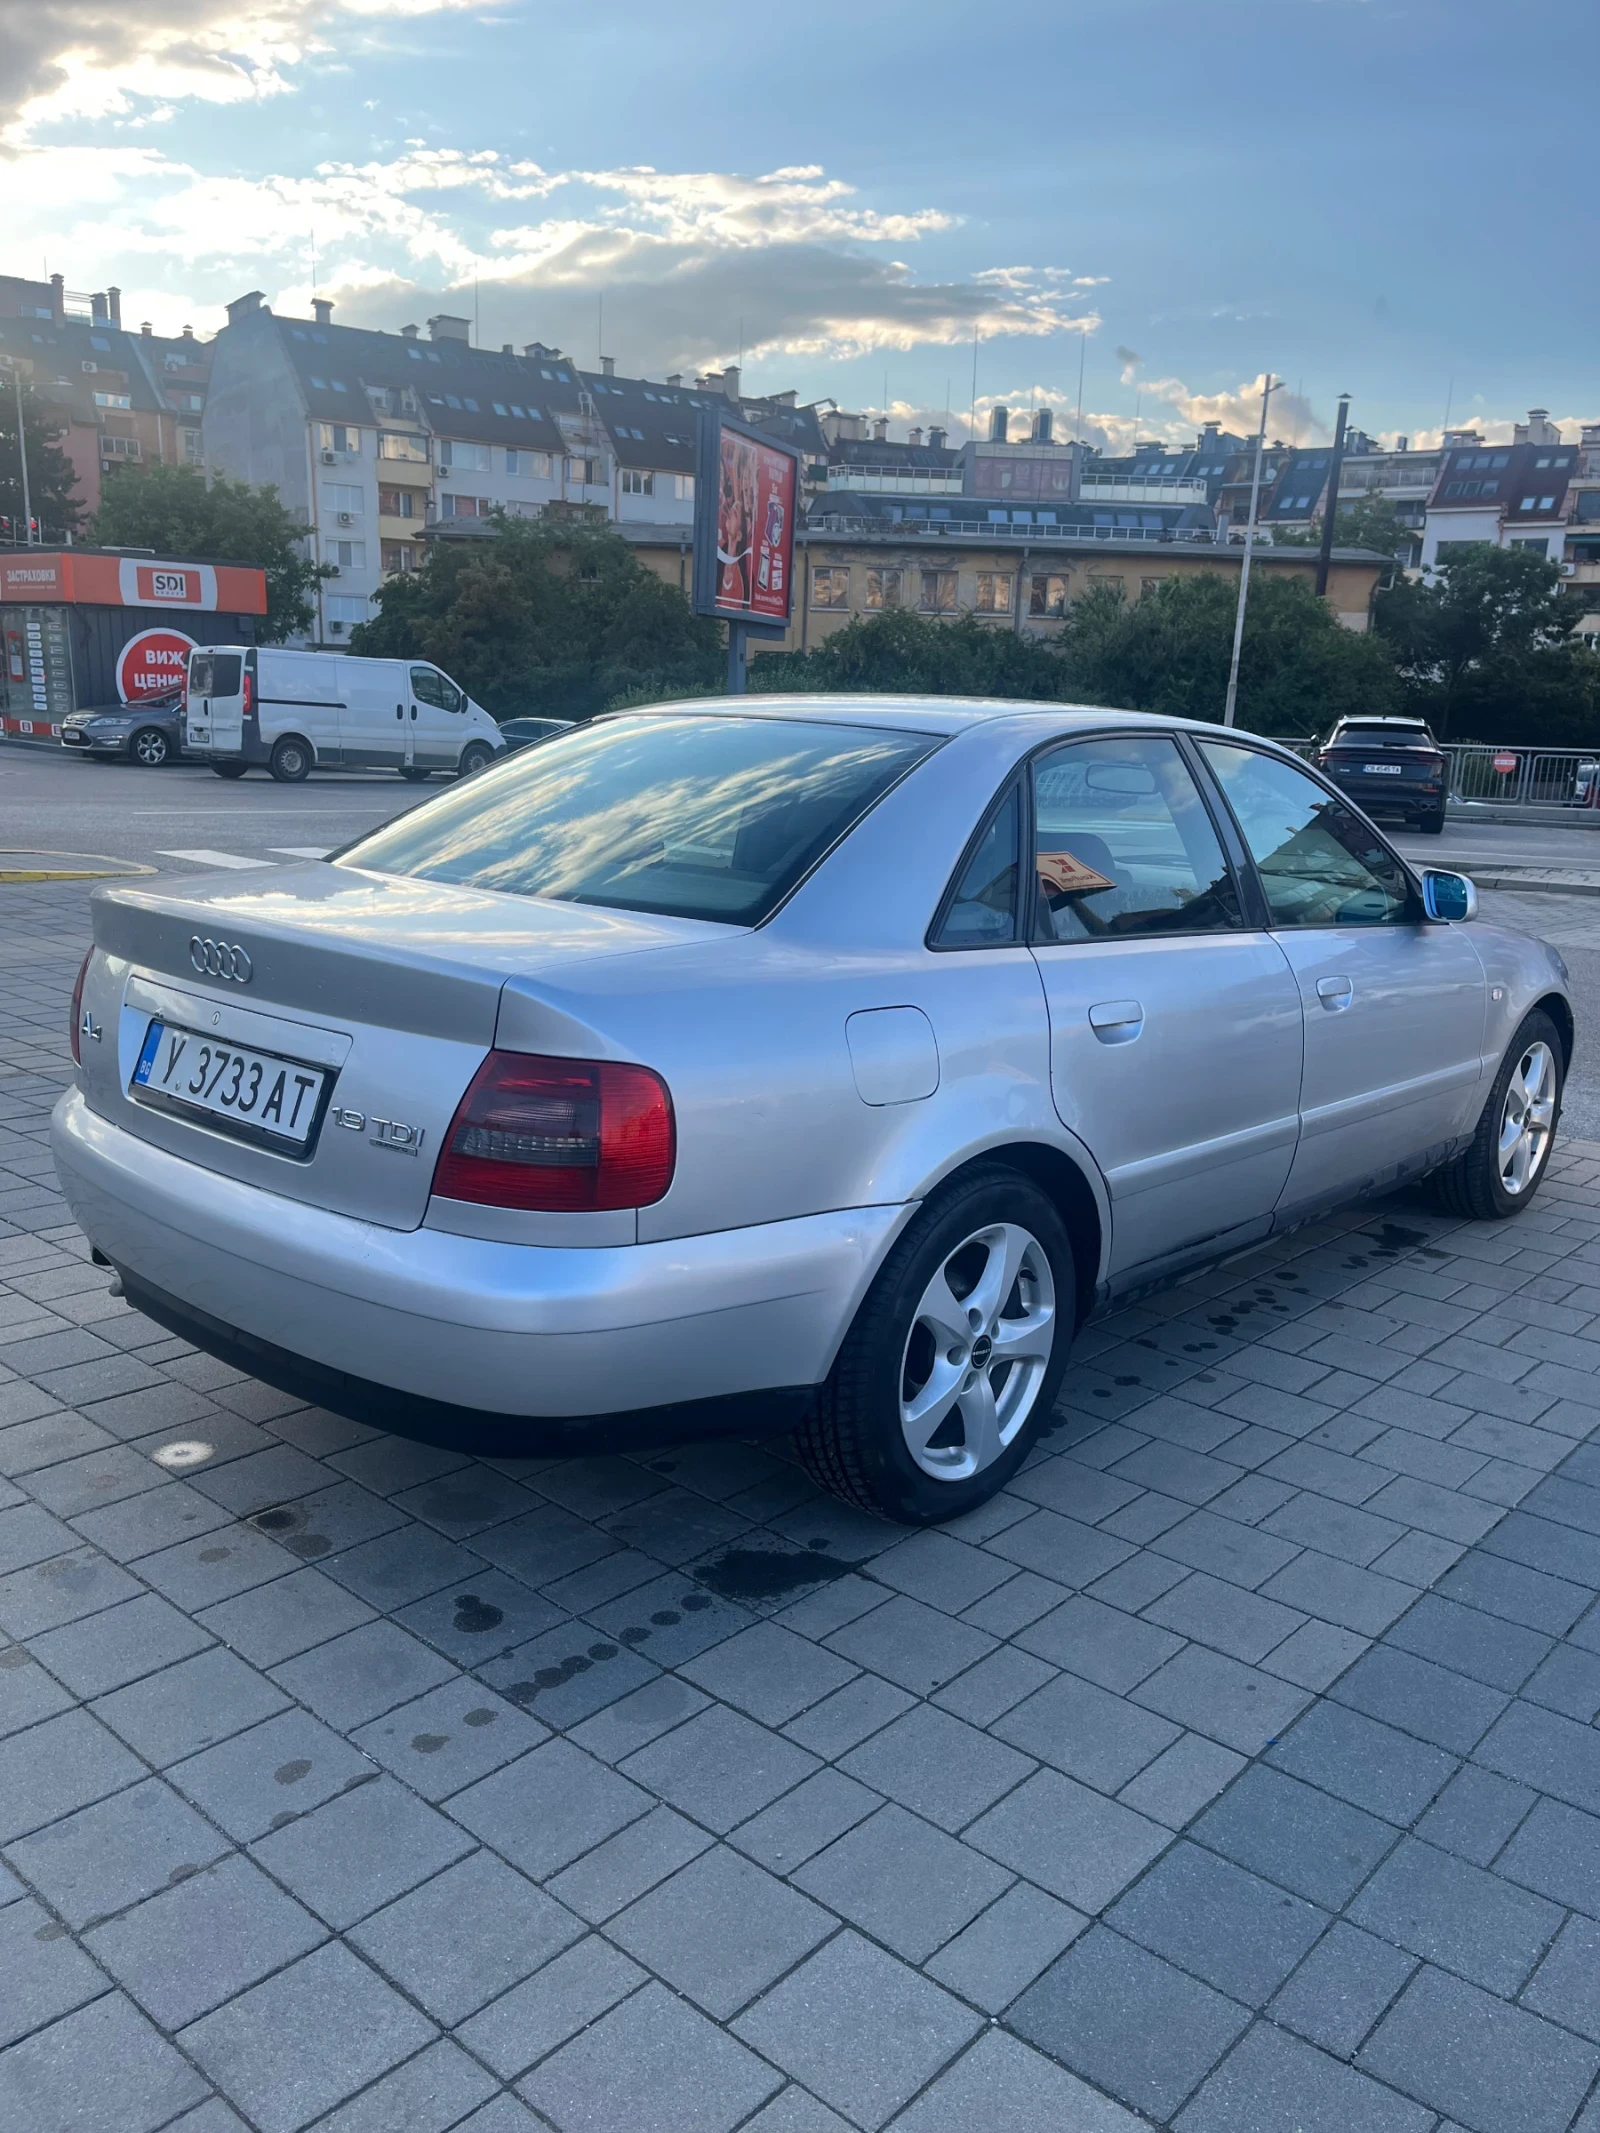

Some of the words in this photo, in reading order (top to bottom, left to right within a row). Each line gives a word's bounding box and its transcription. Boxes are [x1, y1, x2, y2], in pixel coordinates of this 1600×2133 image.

[7, 569, 56, 583] ЗАСТРАХОВКИ
[155, 575, 184, 591] SDI
[145, 650, 184, 665] ВИЖ
[140, 1060, 152, 1076] BG
[188, 1046, 263, 1112] 3733
[261, 1070, 316, 1128] AT
[370, 1116, 425, 1147] TDI
